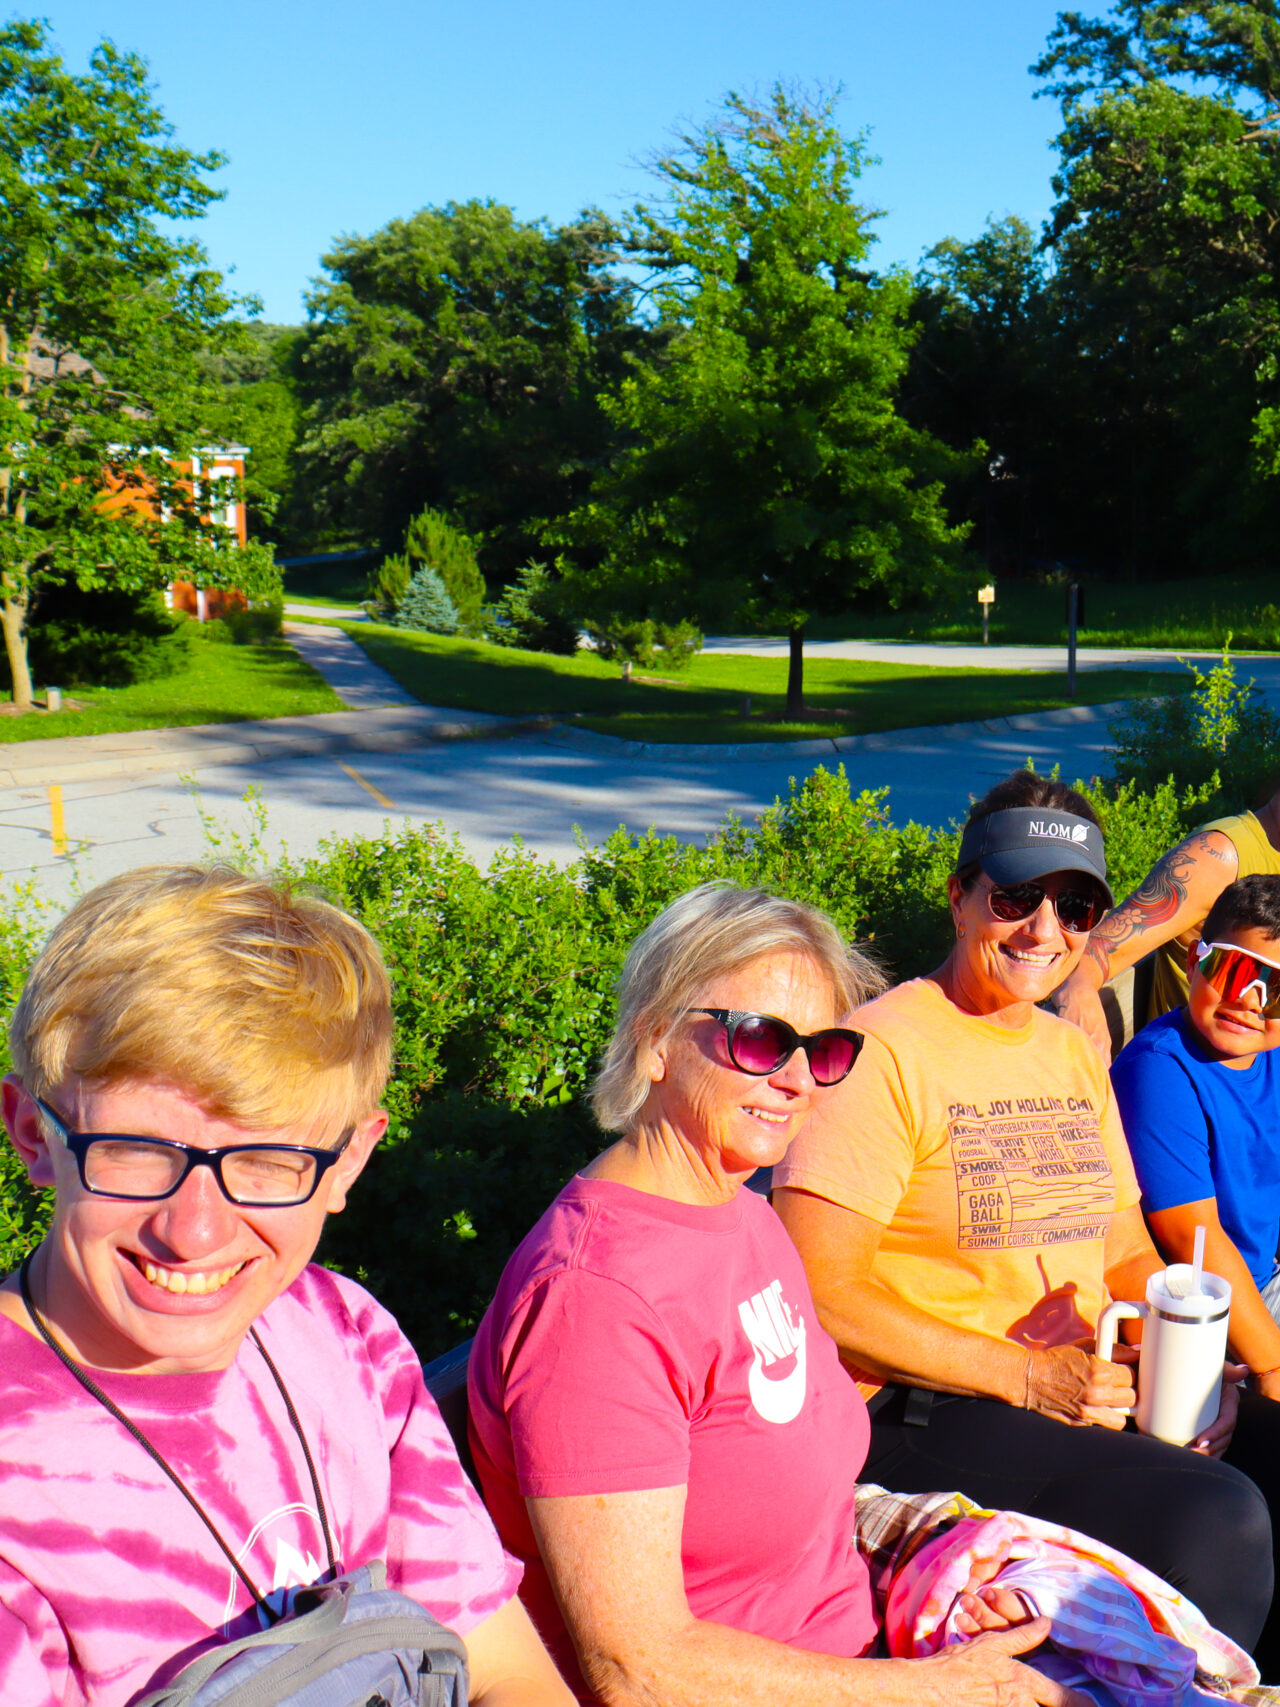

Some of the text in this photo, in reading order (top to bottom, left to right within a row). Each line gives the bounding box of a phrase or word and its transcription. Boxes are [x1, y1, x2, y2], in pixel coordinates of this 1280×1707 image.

[1029, 821, 1071, 839] NLOM
[948, 1103, 984, 1119] CAL
[988, 1100, 1012, 1116] JOY
[990, 1121, 1029, 1135] HORSEBACK
[991, 1138, 1026, 1148] CREATIVE
[1032, 1135, 1057, 1149] FIRST
[1000, 1148, 1027, 1159] ARTS
[1038, 1147, 1065, 1161] WORD
[1031, 1162, 1073, 1177] CRYSTAL
[972, 1175, 997, 1187] COOP
[969, 1192, 1004, 1209] GAGA
[971, 1208, 1004, 1223] BALL
[972, 1226, 1001, 1235] SWIM
[1042, 1227, 1099, 1243] COMMITMENT
[967, 1234, 1035, 1248] SUMMIT COURSE
